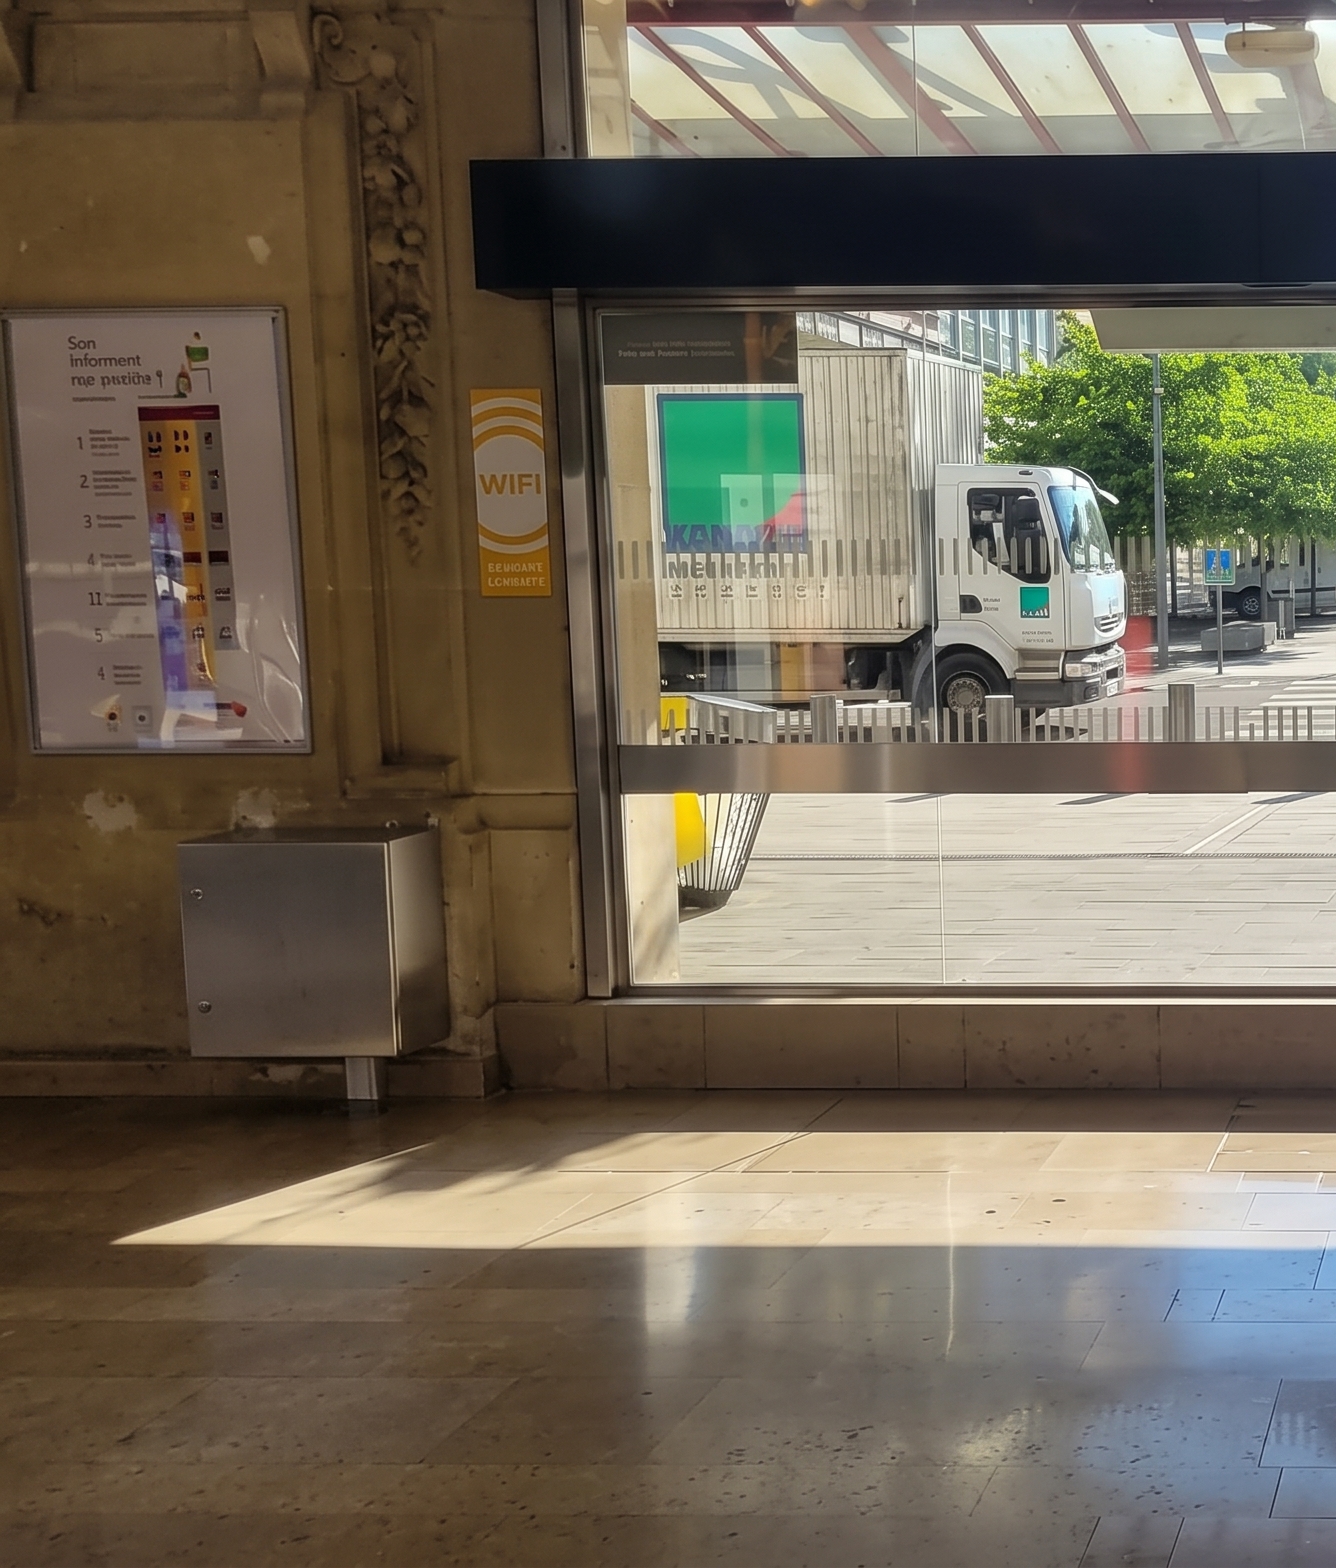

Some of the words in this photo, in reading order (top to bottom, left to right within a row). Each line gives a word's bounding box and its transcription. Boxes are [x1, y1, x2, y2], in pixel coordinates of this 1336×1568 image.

[68, 336, 96, 350] Son
[77, 436, 83, 450] 1
[80, 474, 89, 488] 2
[479, 473, 542, 495] WIFI
[83, 514, 92, 528] 3
[94, 628, 103, 642] 5
